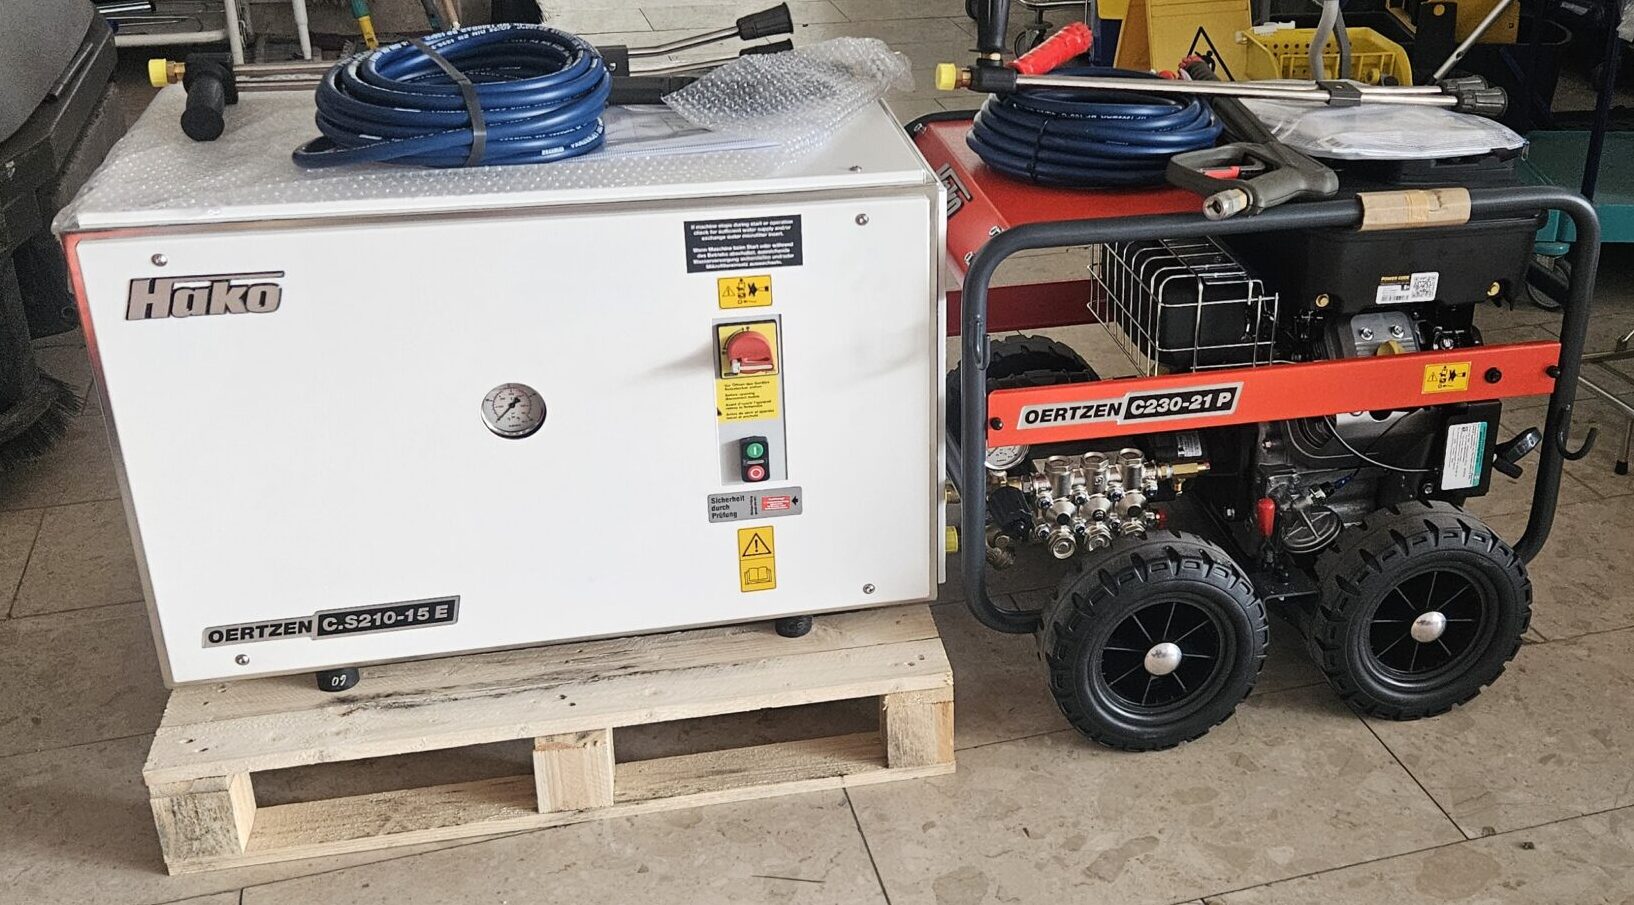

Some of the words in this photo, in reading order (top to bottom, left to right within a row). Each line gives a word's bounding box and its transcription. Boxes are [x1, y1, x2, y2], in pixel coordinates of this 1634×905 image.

[126, 271, 285, 320] Hako
[1024, 402, 1123, 425] OERTZEN
[1130, 393, 1214, 416] C230-21
[1216, 392, 1232, 407] P
[711, 496, 744, 504] Sicherheit
[208, 619, 313, 644] OERTZEN
[322, 606, 430, 632] C.S210-15
[434, 604, 448, 618] E
